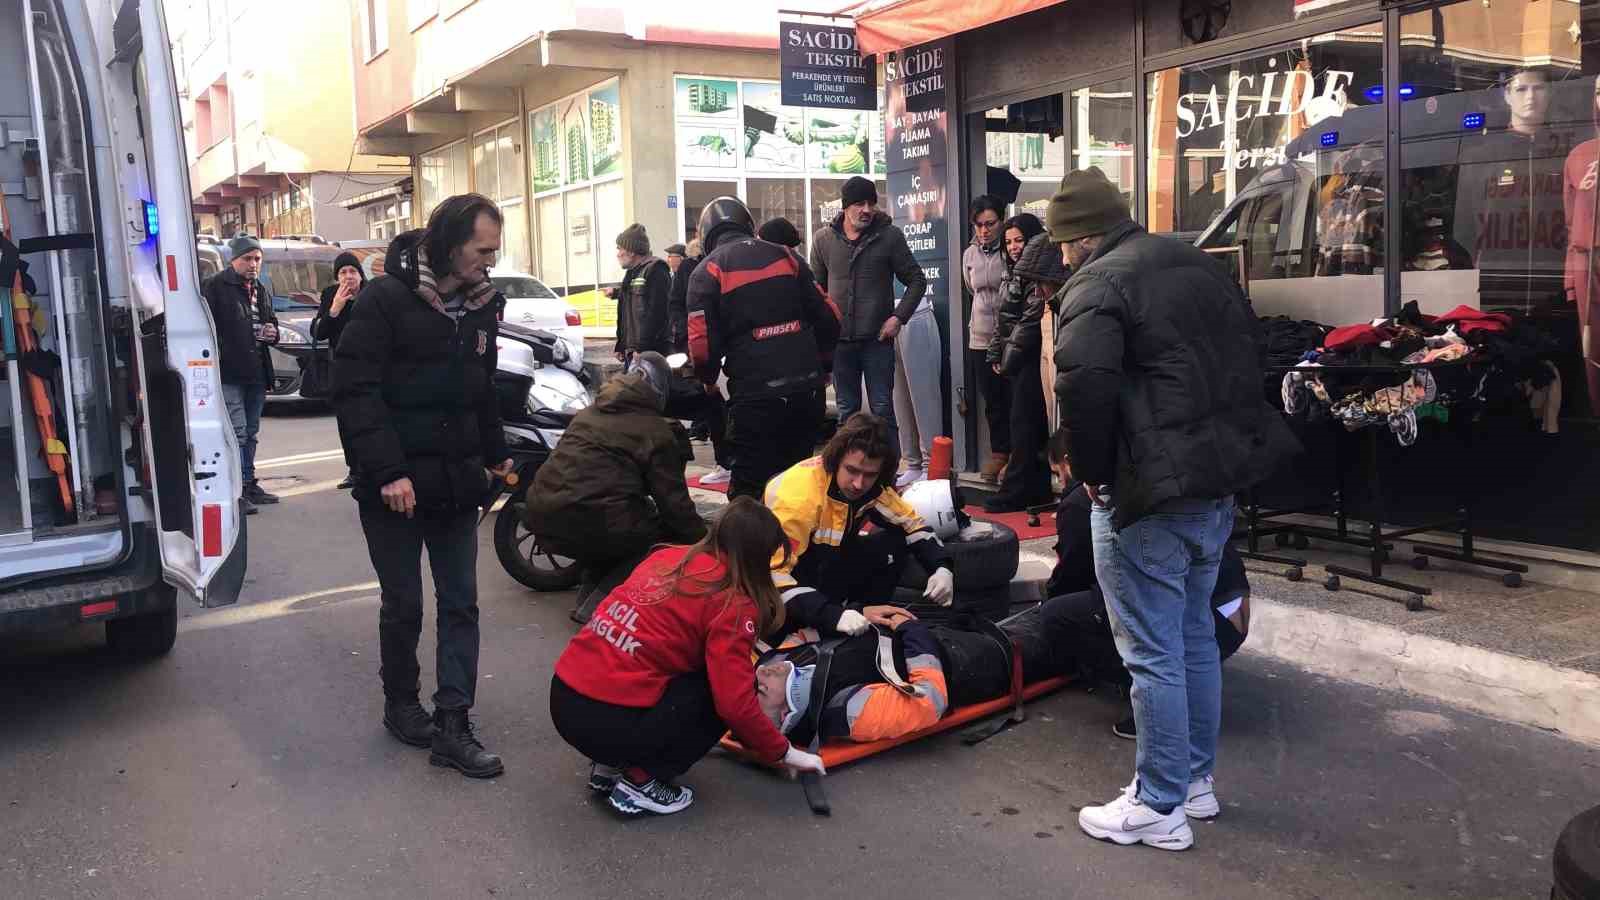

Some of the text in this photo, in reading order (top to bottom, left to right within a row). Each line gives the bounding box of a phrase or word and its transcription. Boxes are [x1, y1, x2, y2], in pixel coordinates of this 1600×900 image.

[806, 52, 867, 69] TEKSTİL
[886, 47, 943, 82] SACİDE
[791, 71, 831, 82] PERAKENDE
[833, 74, 842, 83] VE
[900, 72, 945, 98] TEKSTİL
[802, 92, 857, 105] SATIŞ NOKTASI
[912, 108, 940, 125] BAYAN
[902, 143, 930, 160] TAKIMI
[911, 174, 921, 190] İÇ
[897, 190, 937, 209] ÇAMAŞIRI
[903, 222, 932, 239] ÇORAP
[906, 236, 936, 253] EŞİTLERİ
[606, 600, 641, 633] ACİL
